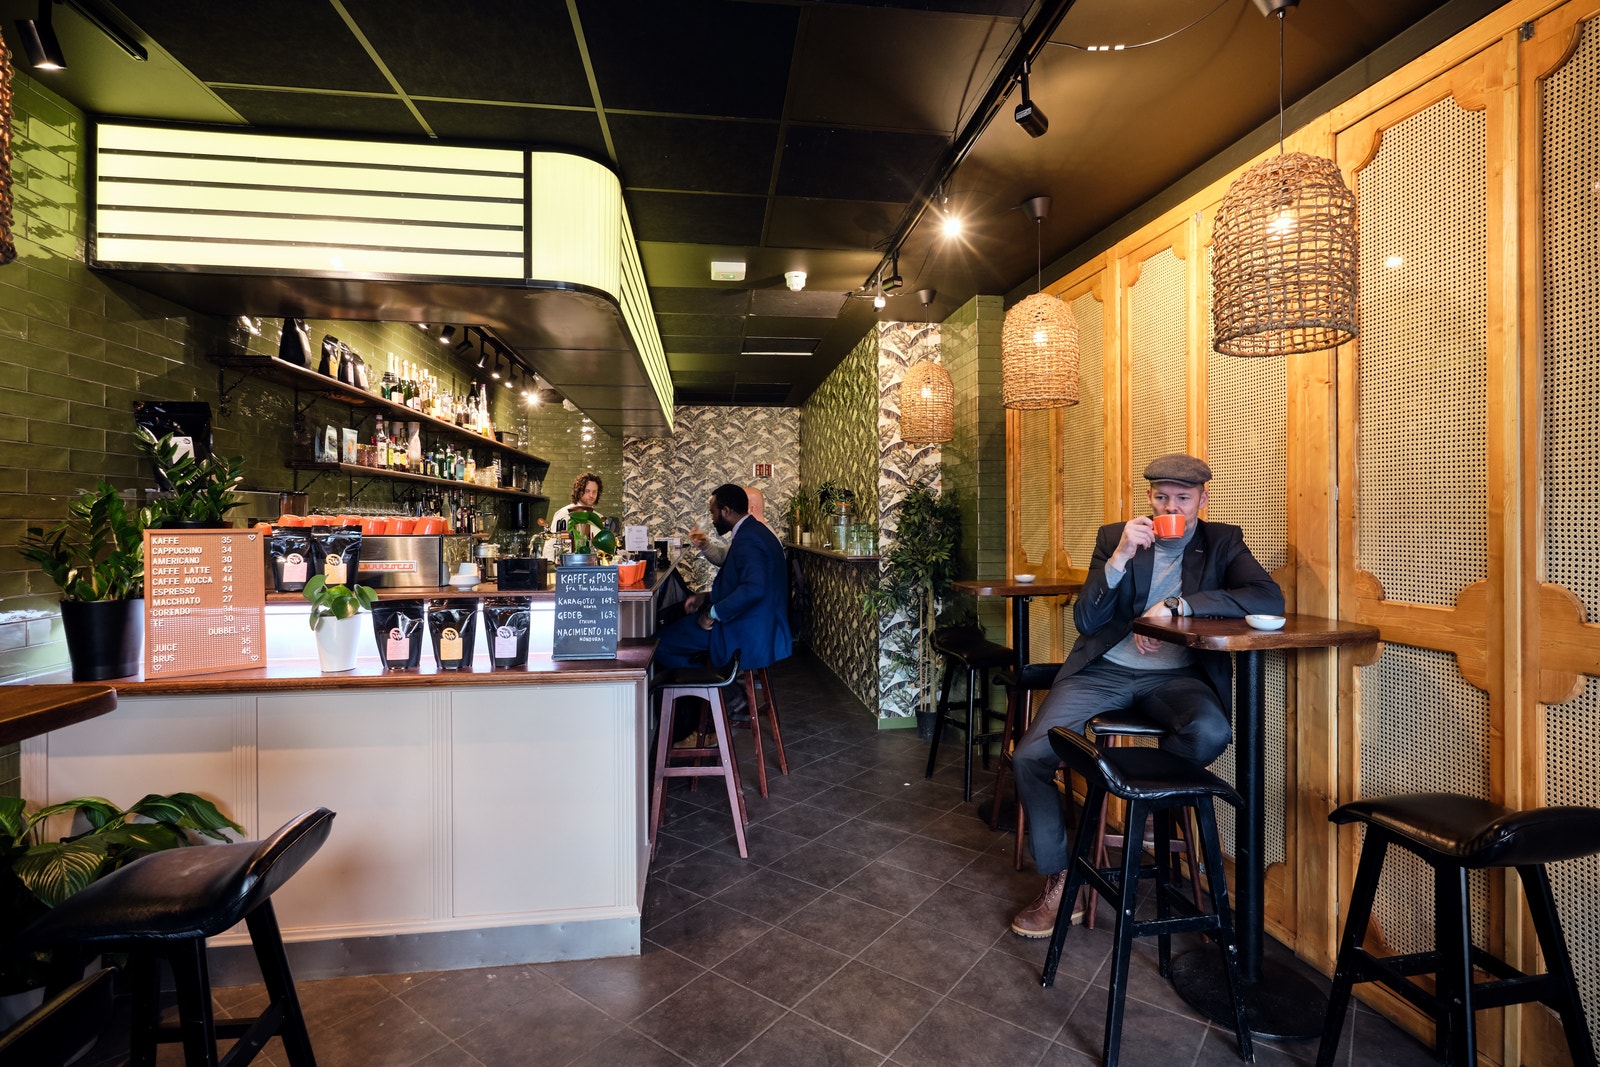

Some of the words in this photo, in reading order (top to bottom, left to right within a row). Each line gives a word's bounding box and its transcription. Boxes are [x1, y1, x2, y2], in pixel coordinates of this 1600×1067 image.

[152, 537, 179, 545] KAFFE
[152, 547, 202, 555] CAPPUCCINO
[152, 557, 200, 565] AMERICANO
[561, 574, 588, 584] KAFFE
[597, 573, 617, 584] POSE
[153, 587, 195, 596] ESPRESSO
[153, 597, 201, 606] MACCHIATO
[153, 608, 191, 617] CORTADO
[558, 611, 583, 620] GEDEB
[208, 626, 238, 636] DUBBEL
[558, 627, 602, 636] NACIMIENTO
[153, 644, 178, 652] JUICE
[153, 655, 175, 663] BRUS
